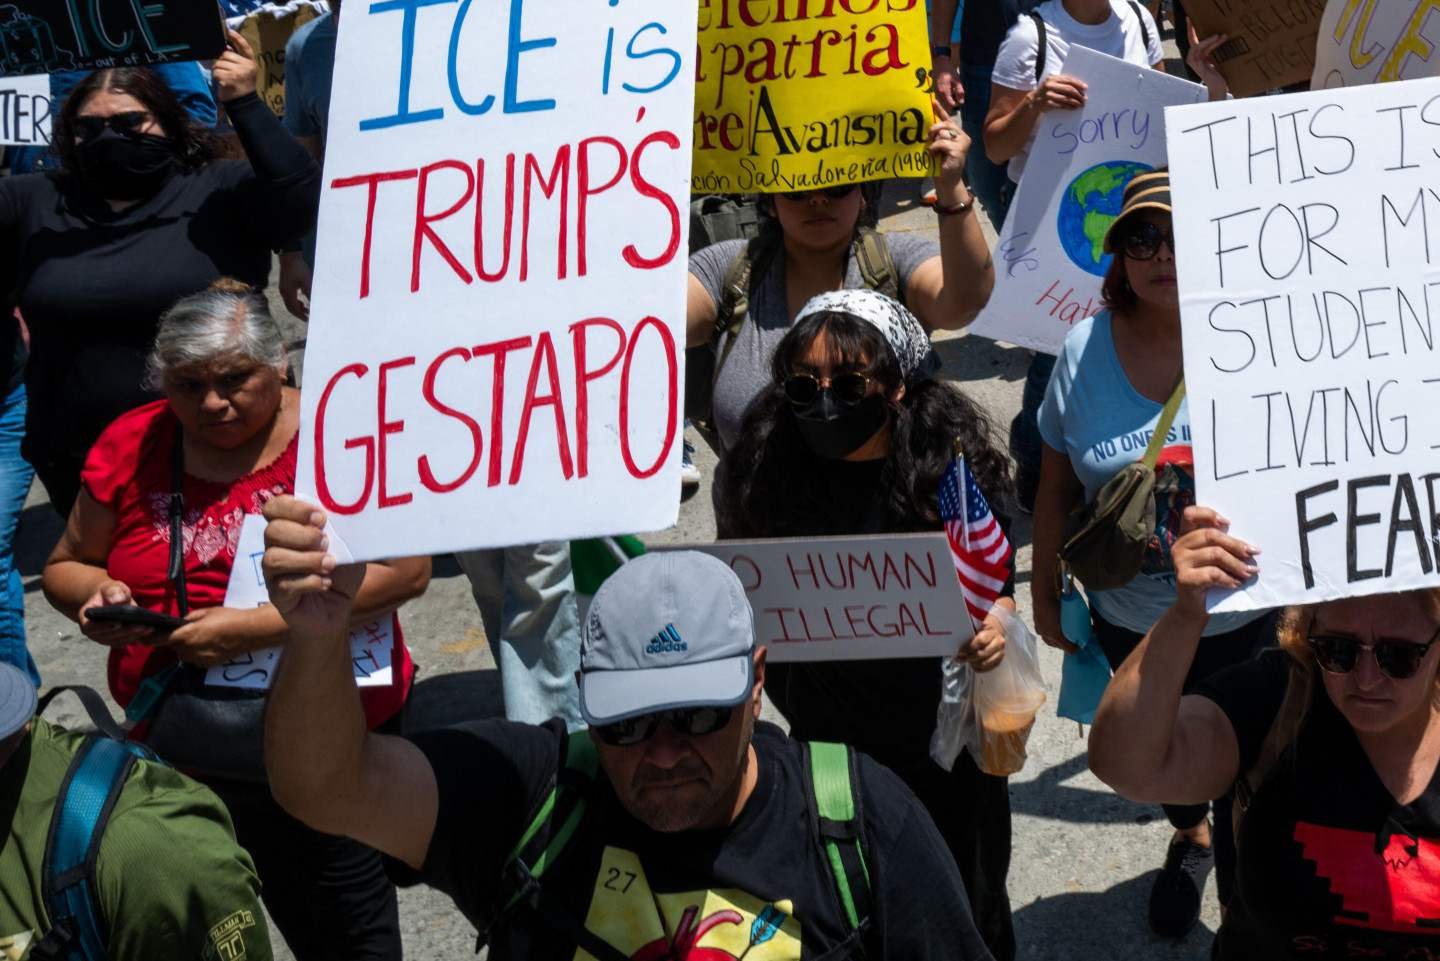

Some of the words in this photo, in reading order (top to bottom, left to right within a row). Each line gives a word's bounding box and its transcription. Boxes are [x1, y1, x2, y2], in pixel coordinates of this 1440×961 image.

[1051, 107, 1151, 155] Sorry
[1181, 103, 1356, 190] THIS
[738, 153, 889, 191] Salvadoreña
[891, 150, 938, 178] (1980)
[330, 105, 682, 299] TRUMP'S
[1209, 201, 1350, 289] FOR
[314, 315, 679, 516] GESTAPO
[1211, 379, 1410, 481] LIVING
[1091, 439, 1118, 464] NO
[1120, 429, 1154, 453] ONE
[786, 549, 940, 593] HUMAN
[763, 600, 952, 646] ILLEGAL
[645, 640, 689, 655] adidas
[602, 867, 638, 895] 27
